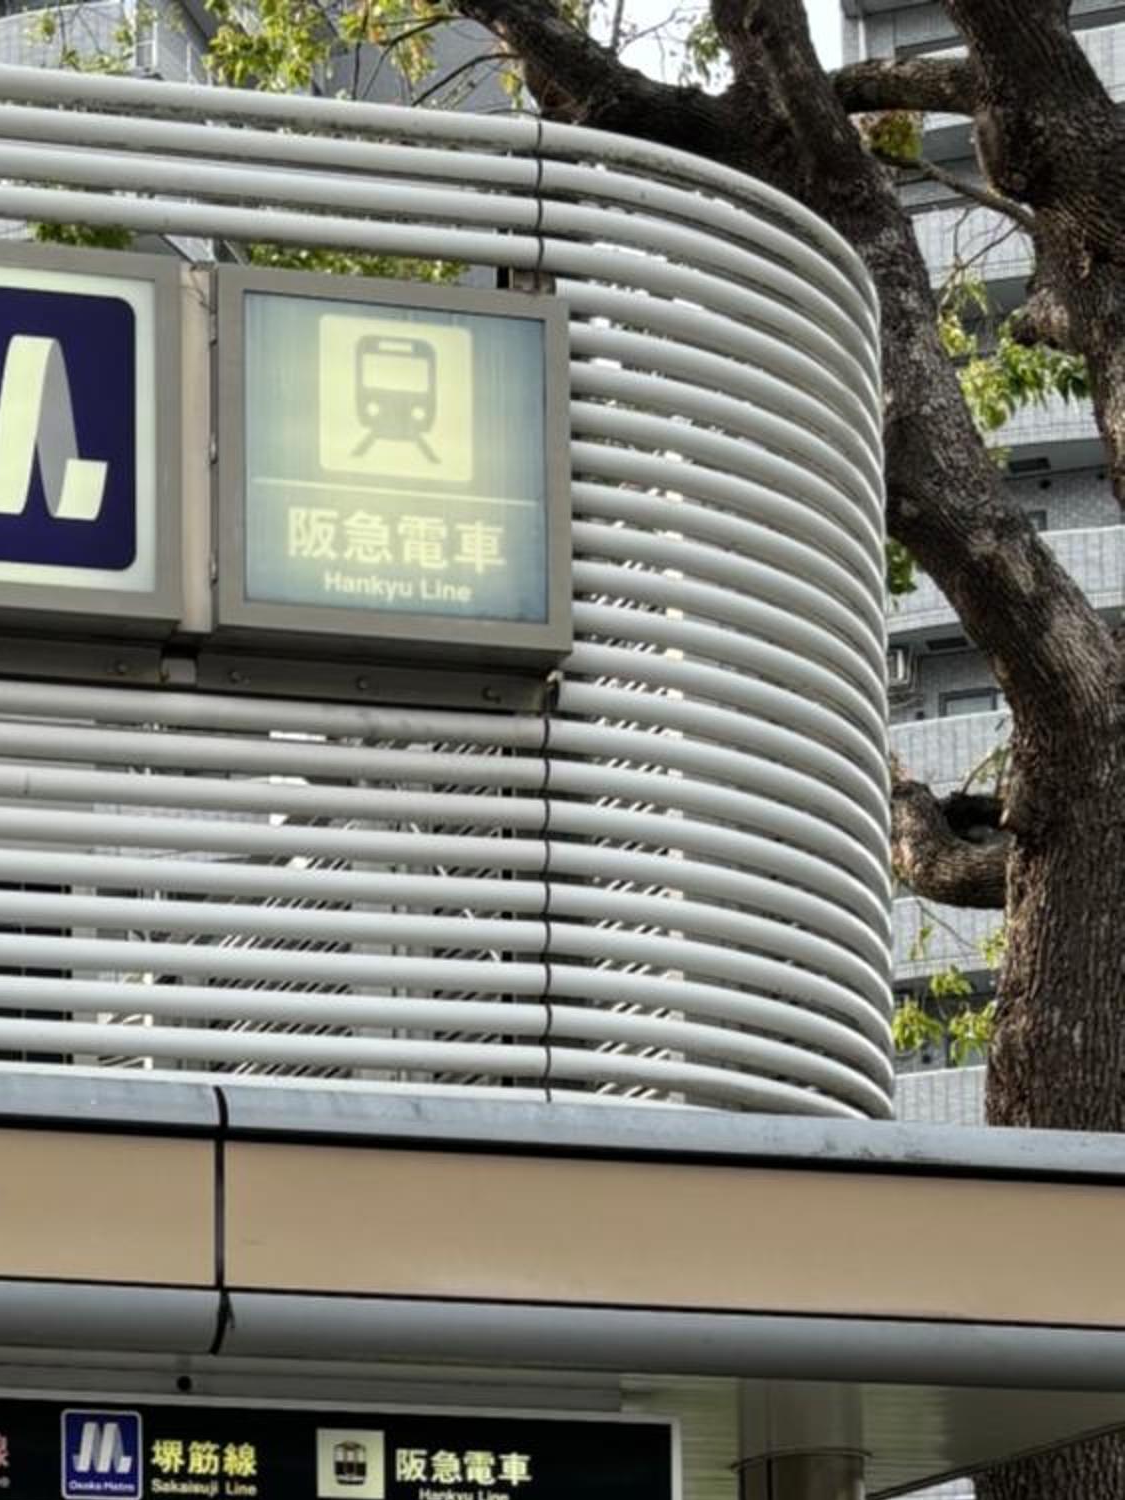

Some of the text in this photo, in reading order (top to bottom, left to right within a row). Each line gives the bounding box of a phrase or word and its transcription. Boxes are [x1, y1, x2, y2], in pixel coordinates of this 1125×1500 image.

[288, 506, 507, 574] 阪急電車
[325, 571, 474, 603] Hankyu Line
[151, 1440, 257, 1477] 堺筋線
[395, 1448, 532, 1486] 阪急電車
[151, 1478, 258, 1498] Sakaisuji Line
